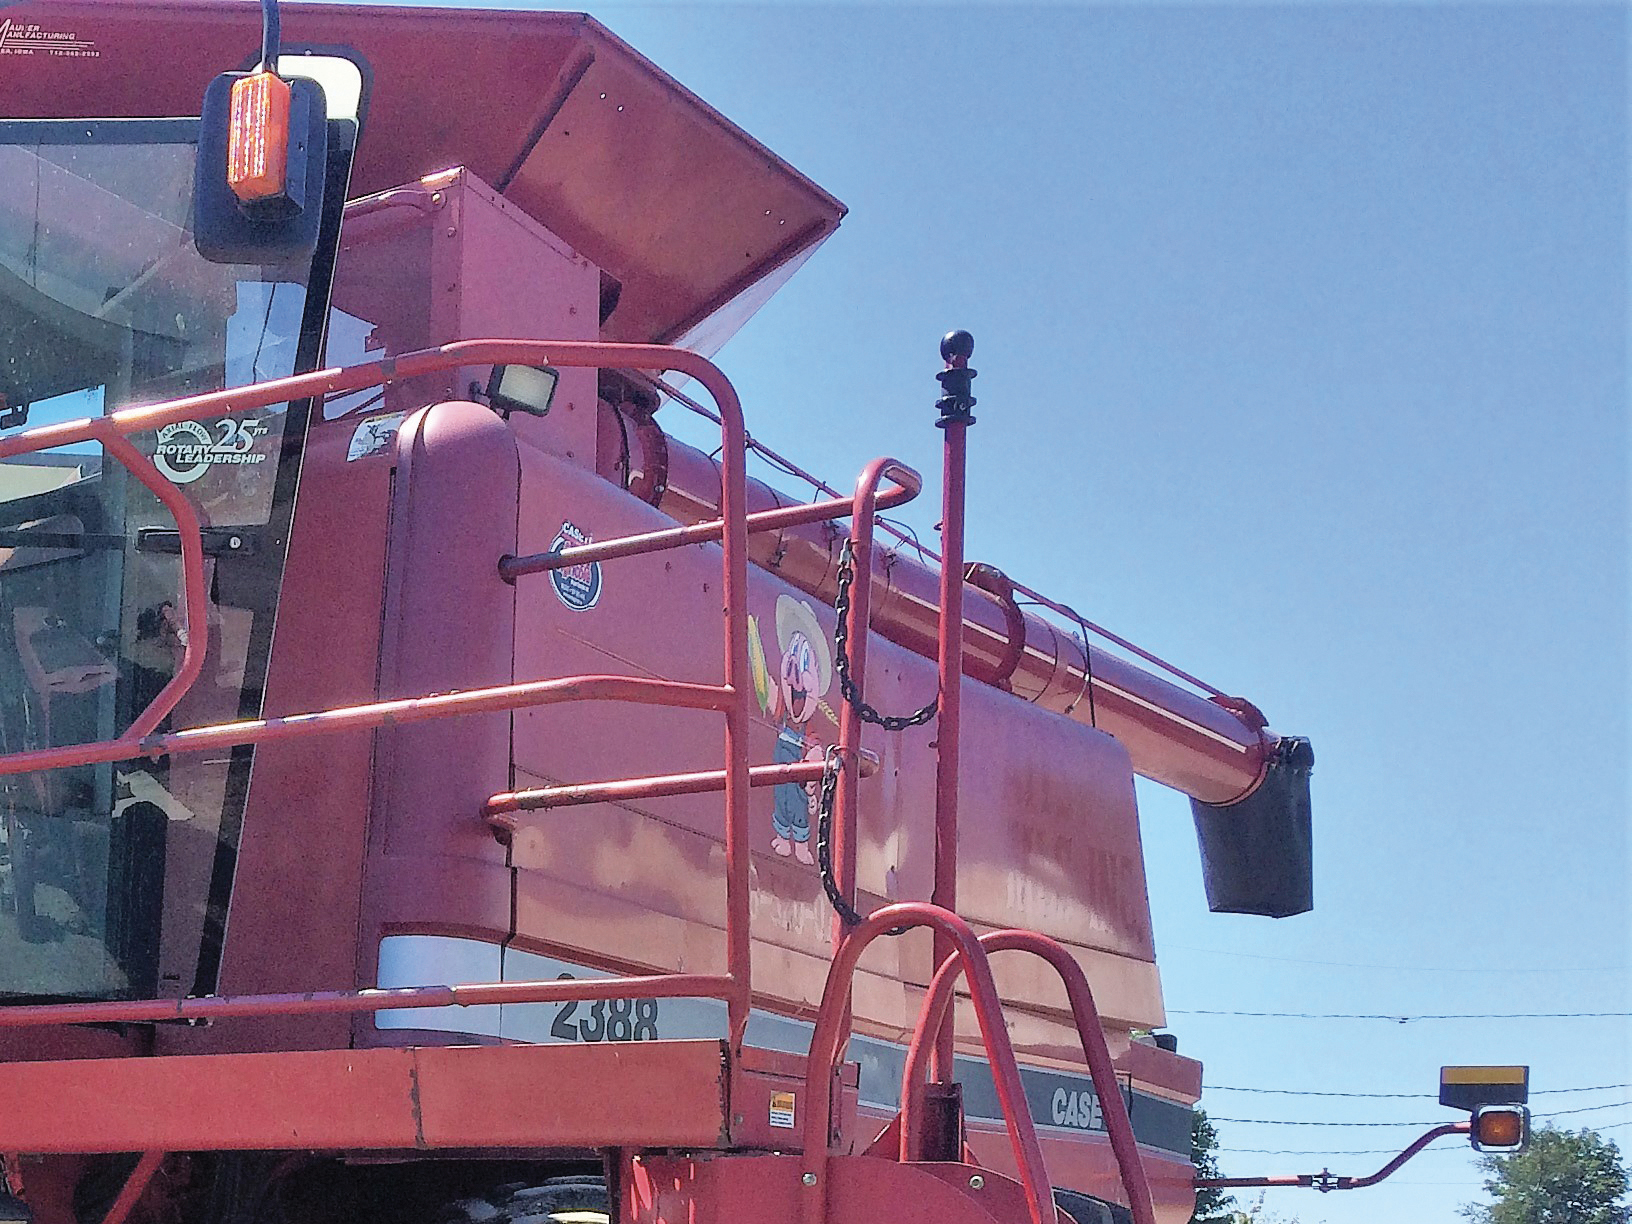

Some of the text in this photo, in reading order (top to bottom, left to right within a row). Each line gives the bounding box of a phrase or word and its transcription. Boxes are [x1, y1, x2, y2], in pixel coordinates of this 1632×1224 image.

[156, 444, 212, 456] ROTARY
[210, 418, 259, 454] 25
[175, 453, 267, 465] LEADERSHIP
[551, 972, 658, 1041] 2388
[1051, 1087, 1103, 1129] CASE
